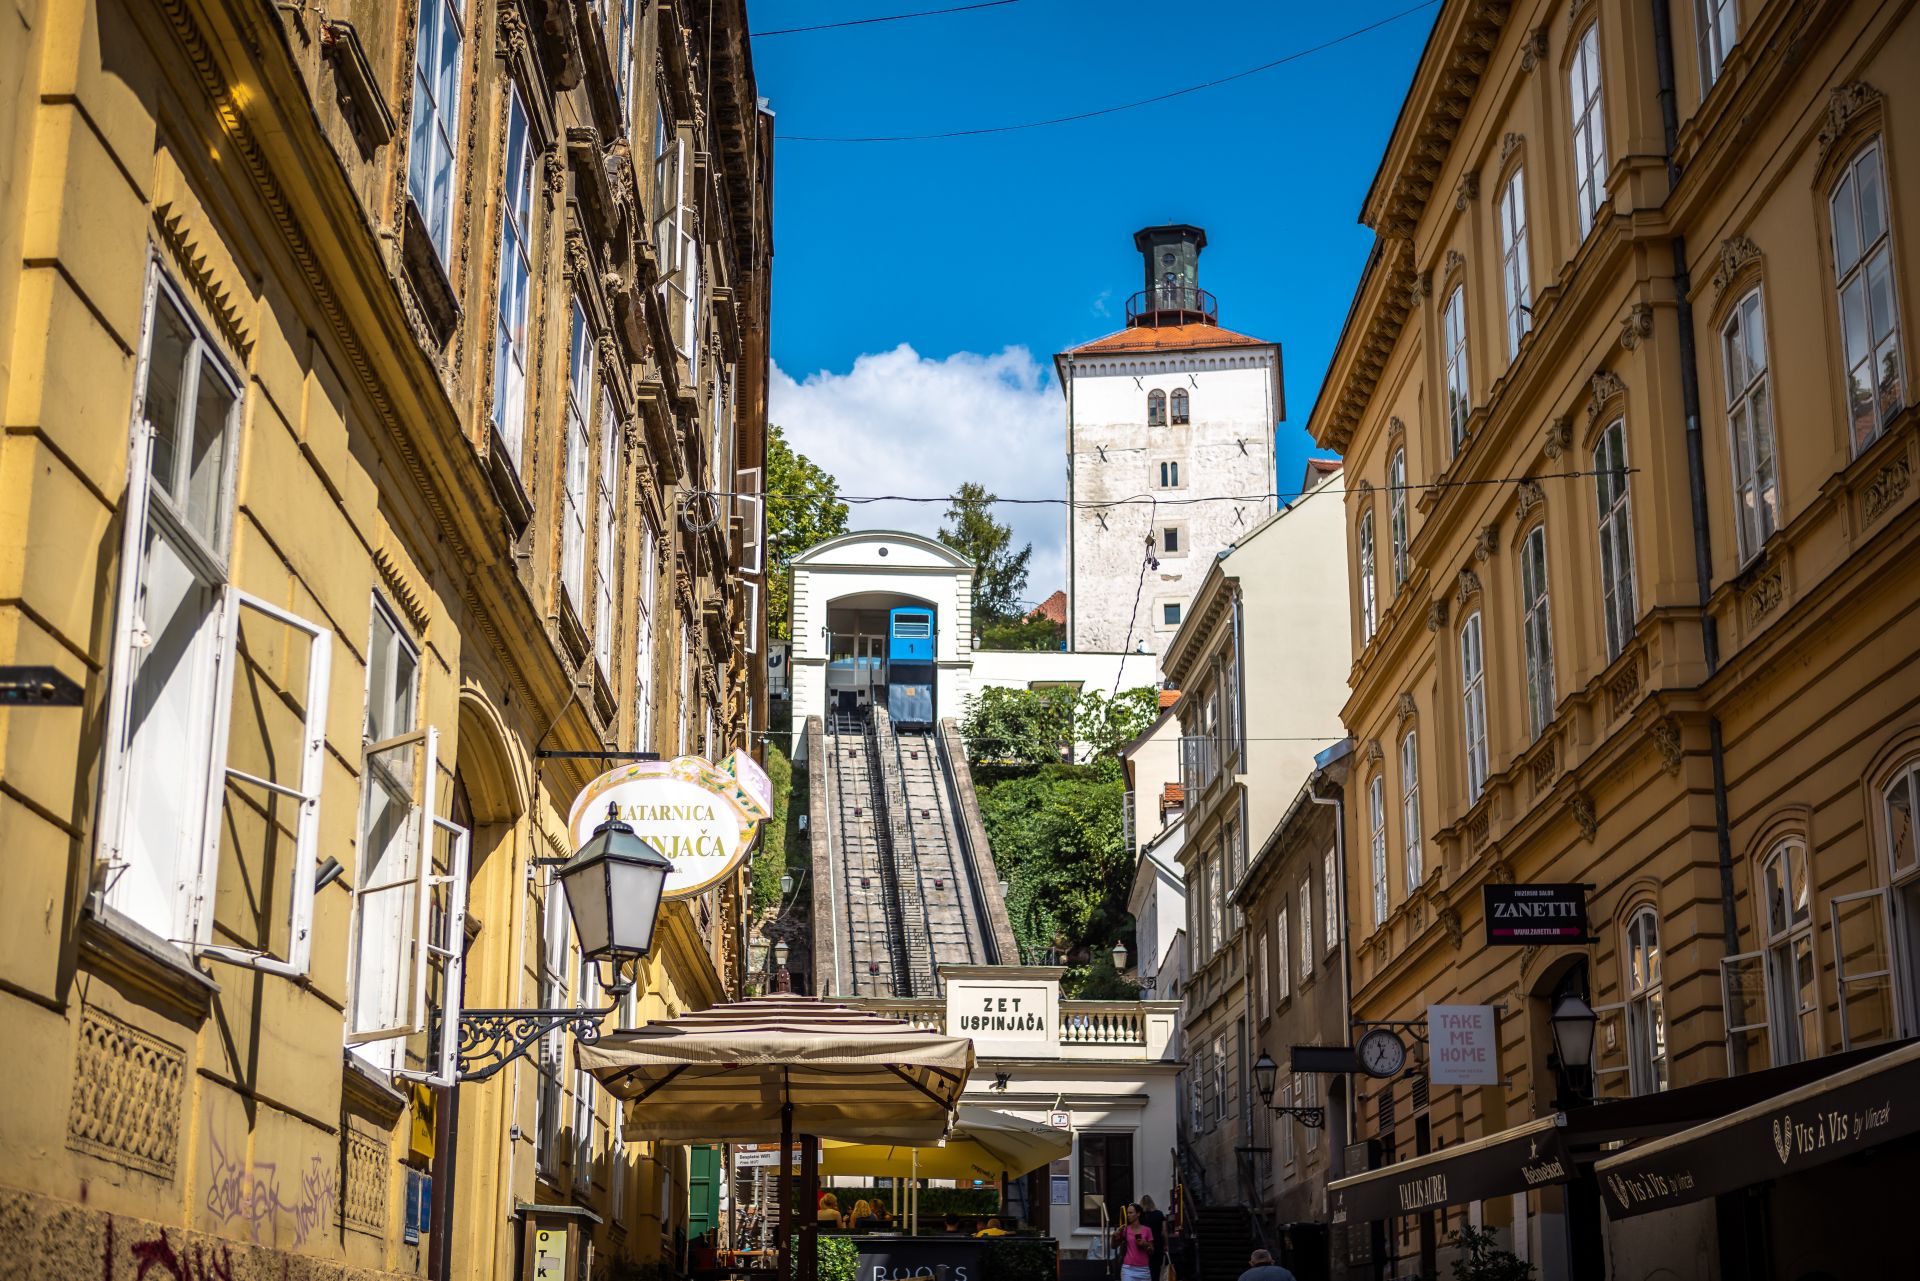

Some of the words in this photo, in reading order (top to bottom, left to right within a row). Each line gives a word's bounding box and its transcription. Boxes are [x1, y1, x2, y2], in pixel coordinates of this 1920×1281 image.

[909, 643, 914, 654] 1
[1494, 902, 1578, 918] ZANETTI
[983, 997, 1022, 1012] ZET
[960, 1012, 1045, 1031] USPINJAČA
[1440, 1014, 1482, 1029] TAKE
[1450, 1031, 1475, 1045] ME
[1440, 1047, 1486, 1062] HOME
[1853, 1112, 1864, 1140] by
[1865, 1100, 1891, 1131] Vincek
[1521, 1157, 1565, 1184] Heineken
[1398, 1179, 1424, 1210] VALLIS
[872, 1265, 968, 1281] ROOS
